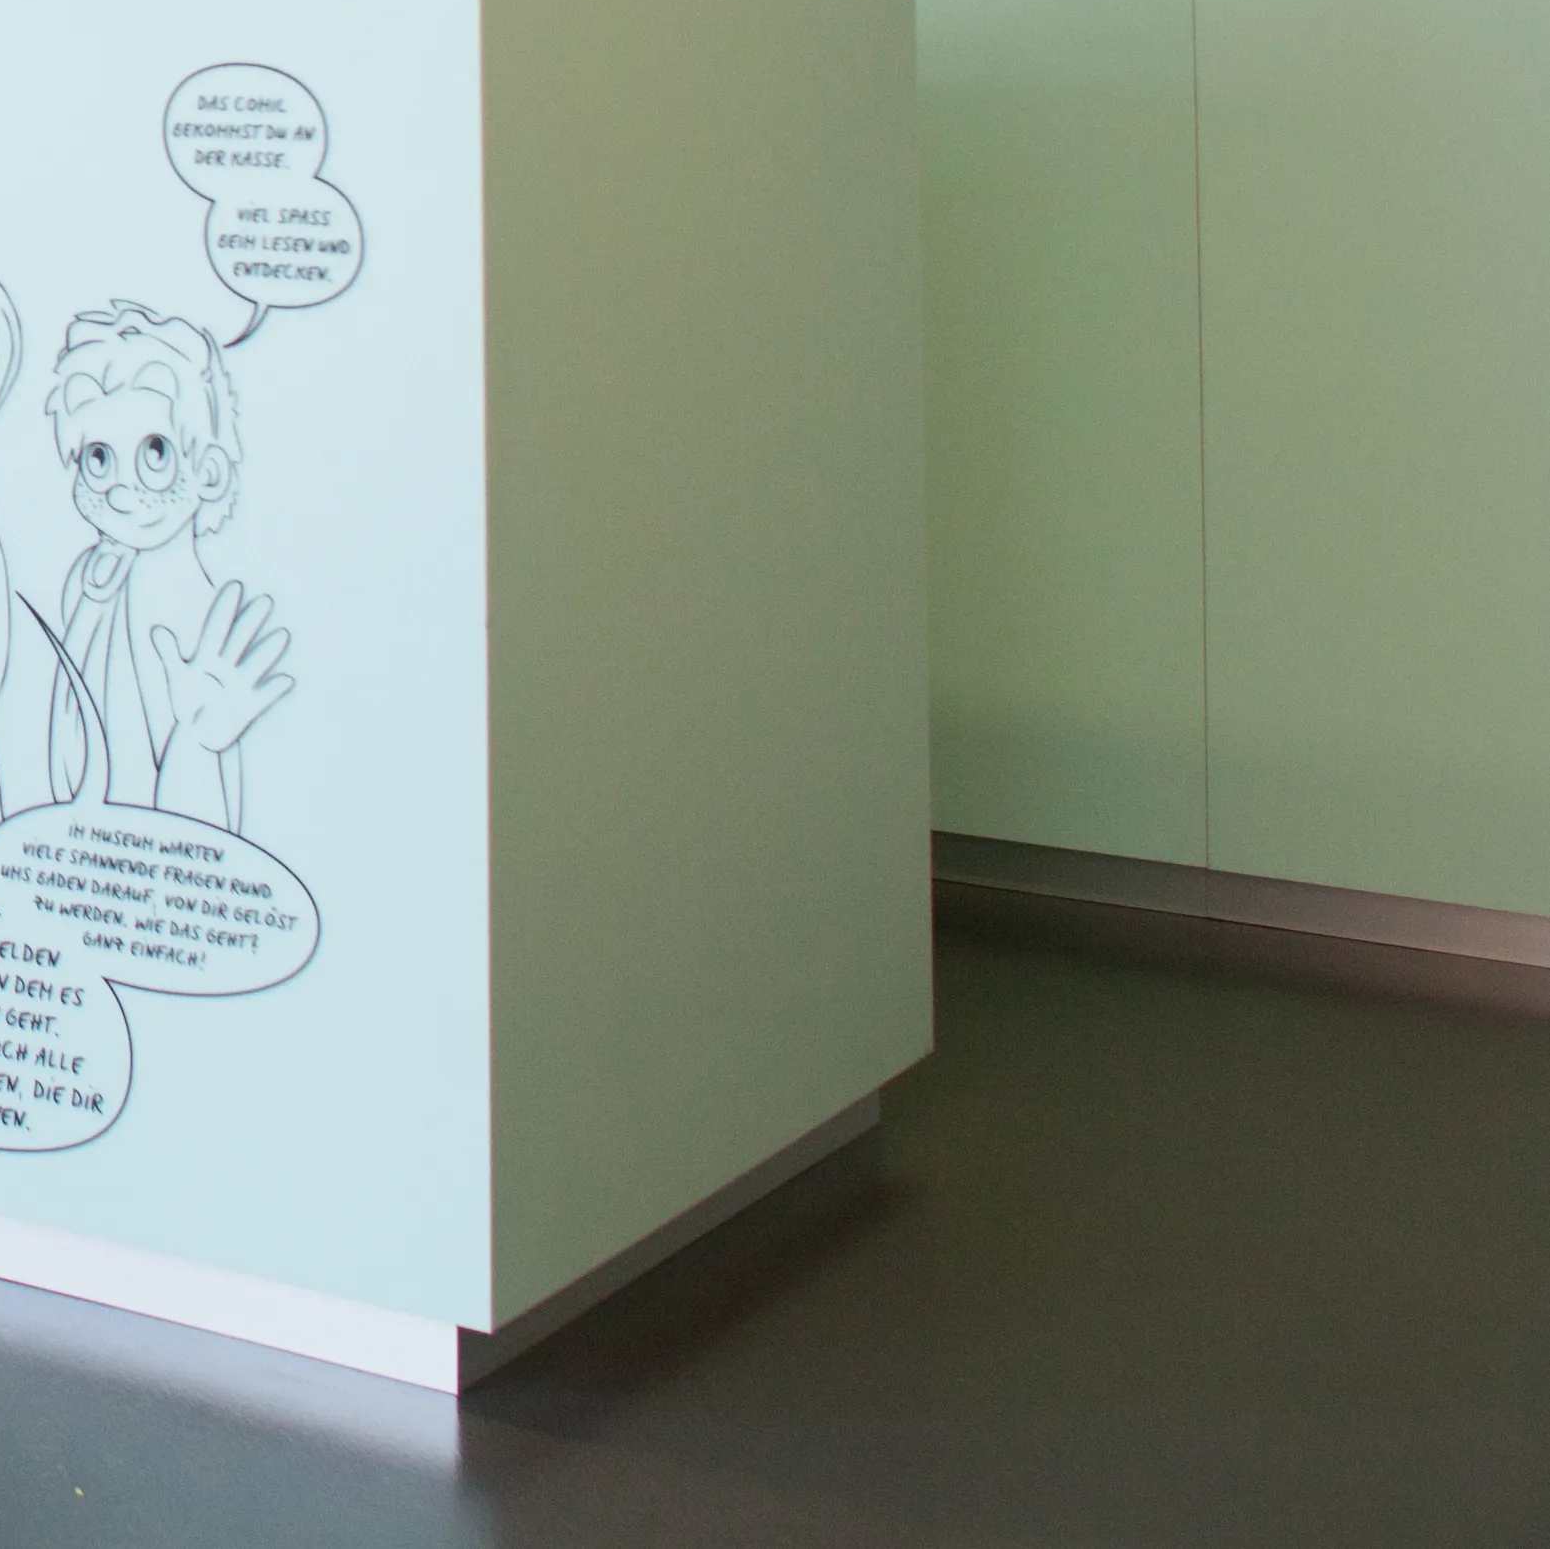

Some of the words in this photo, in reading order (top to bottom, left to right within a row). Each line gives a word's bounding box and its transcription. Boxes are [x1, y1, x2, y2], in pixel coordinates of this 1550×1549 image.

[14, 978, 53, 1002] DEM
[60, 986, 84, 1007] ES
[5, 1008, 60, 1037] GEHT.
[35, 1049, 85, 1075] ALLE
[33, 1077, 65, 1103] DIE
[71, 1085, 104, 1115] DIR
